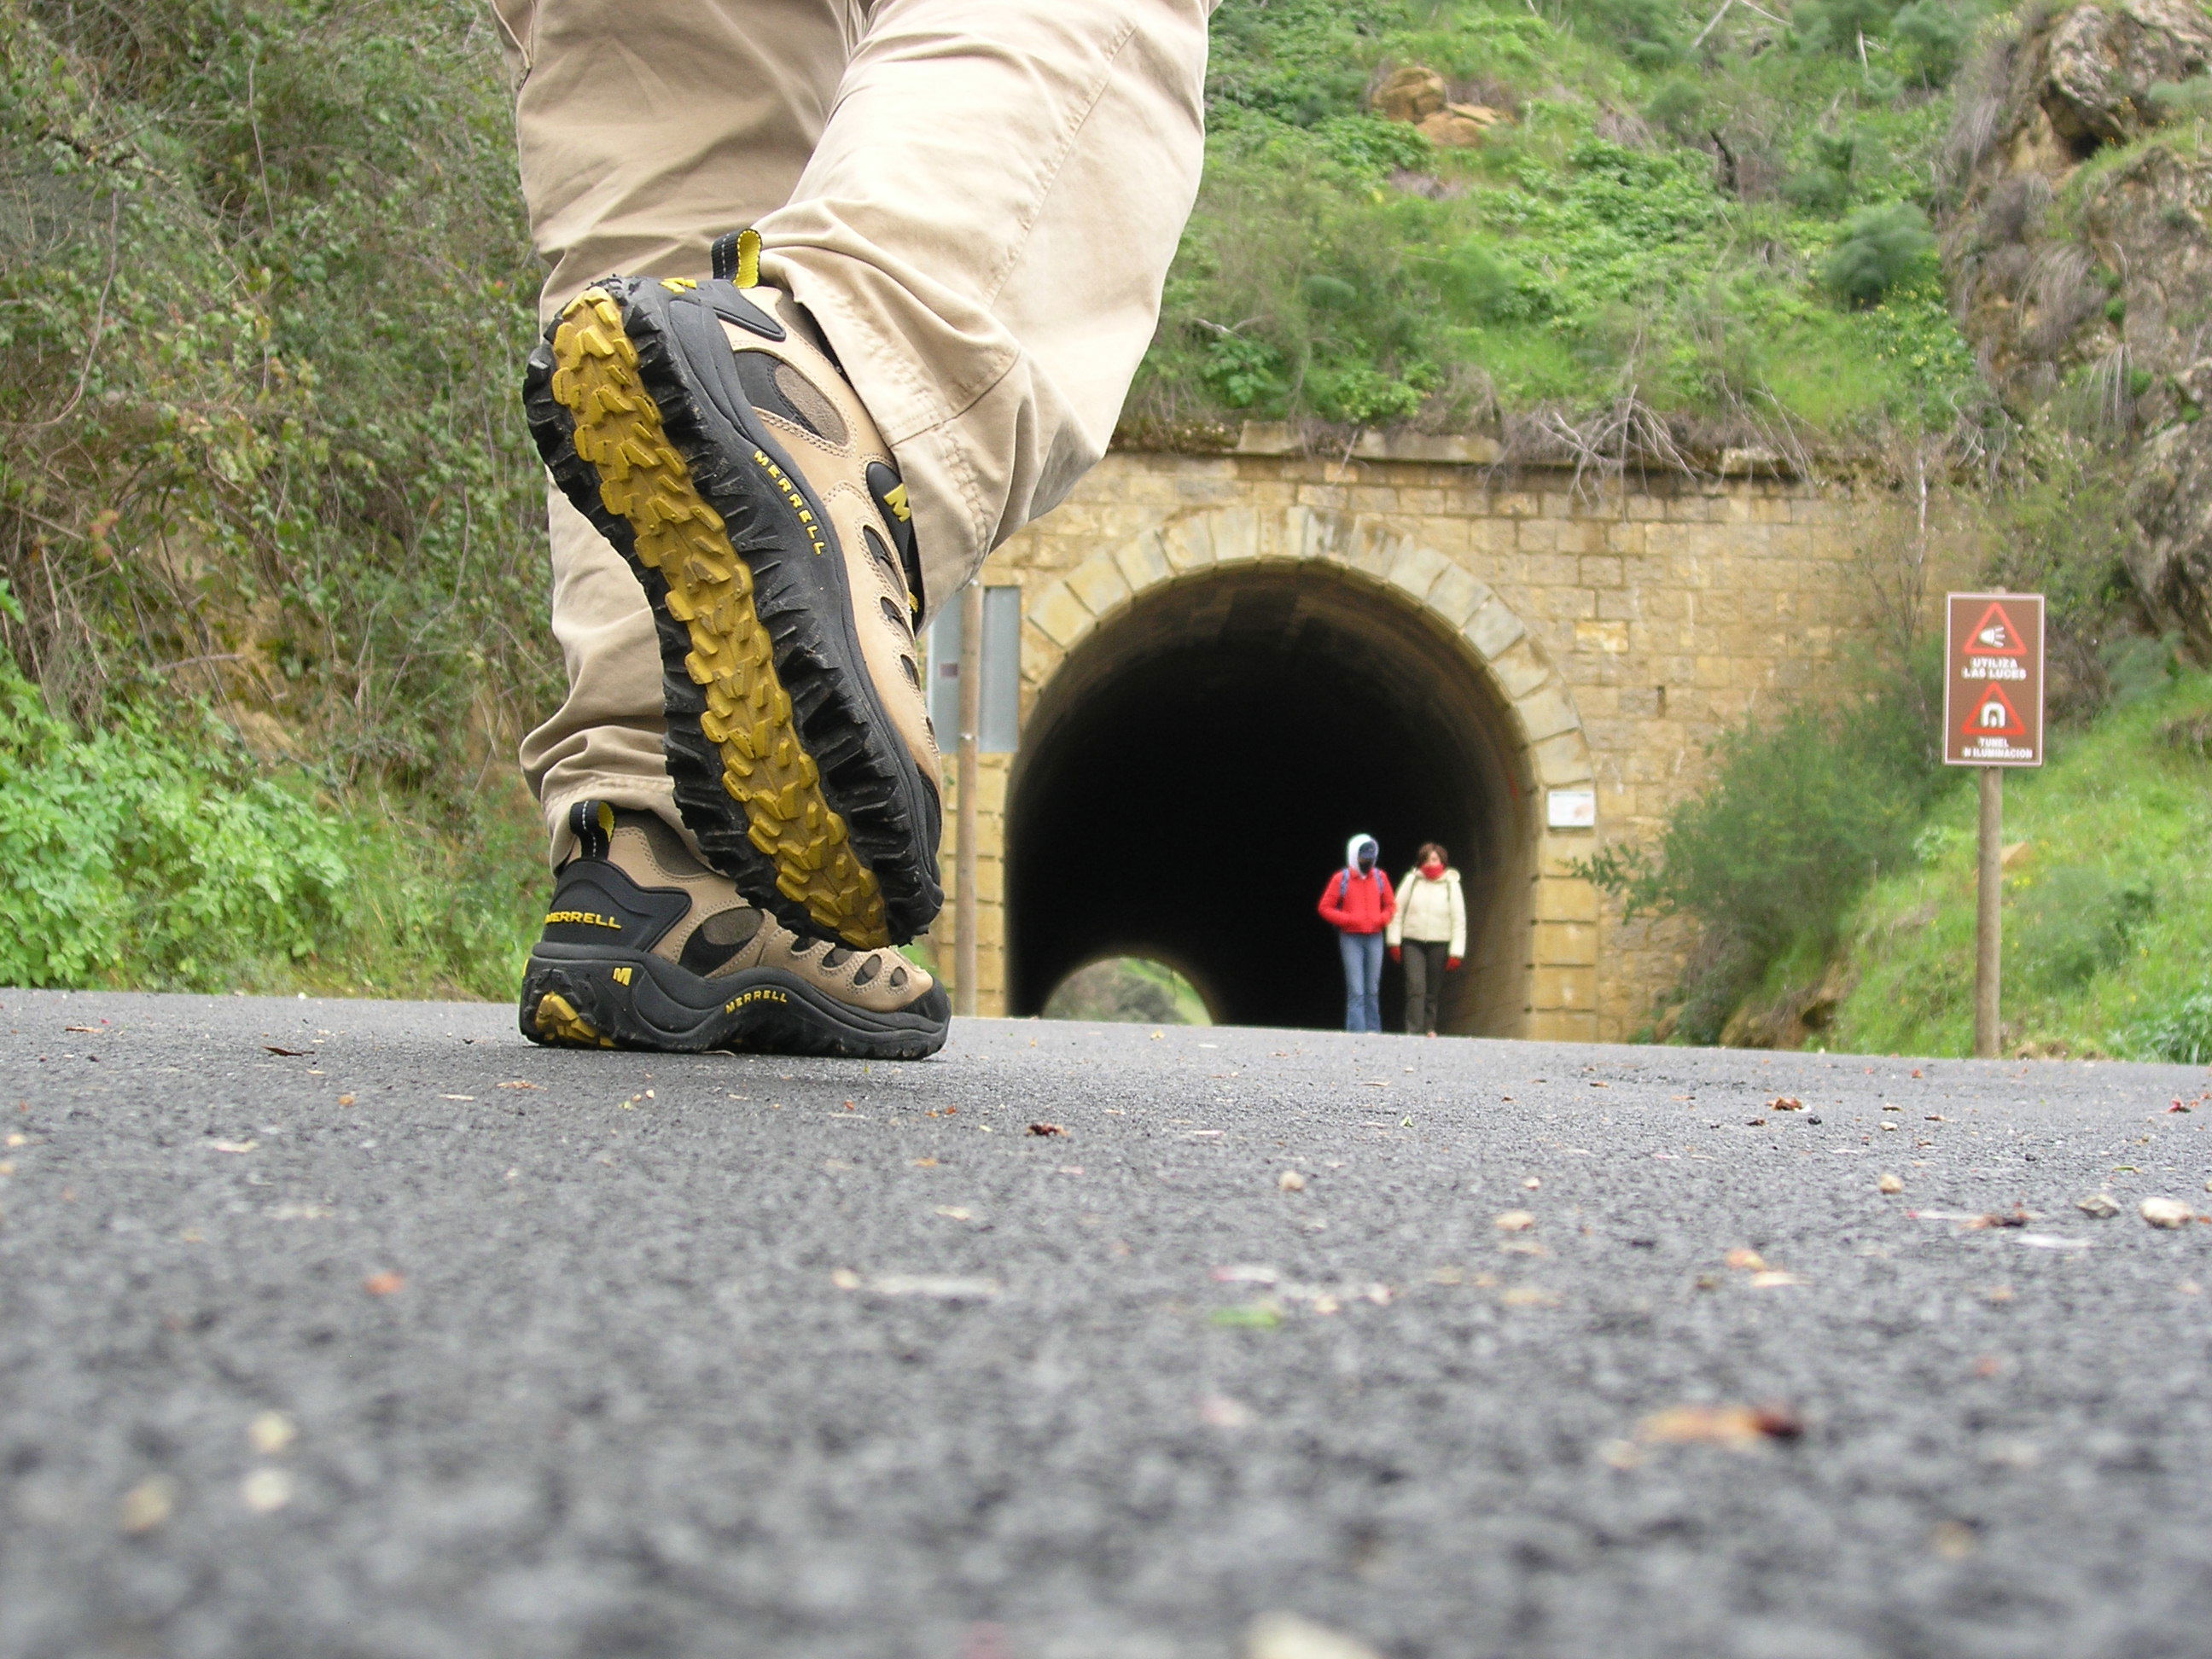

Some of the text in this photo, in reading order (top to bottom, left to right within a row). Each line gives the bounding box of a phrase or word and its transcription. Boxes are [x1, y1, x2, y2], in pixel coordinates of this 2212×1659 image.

[754, 450, 825, 555] MERRELL
[1971, 657, 2018, 668] UTILIZA
[1964, 667, 2027, 680] LAS LUCES
[613, 967, 632, 987] M
[725, 990, 787, 1014] MERRELL
